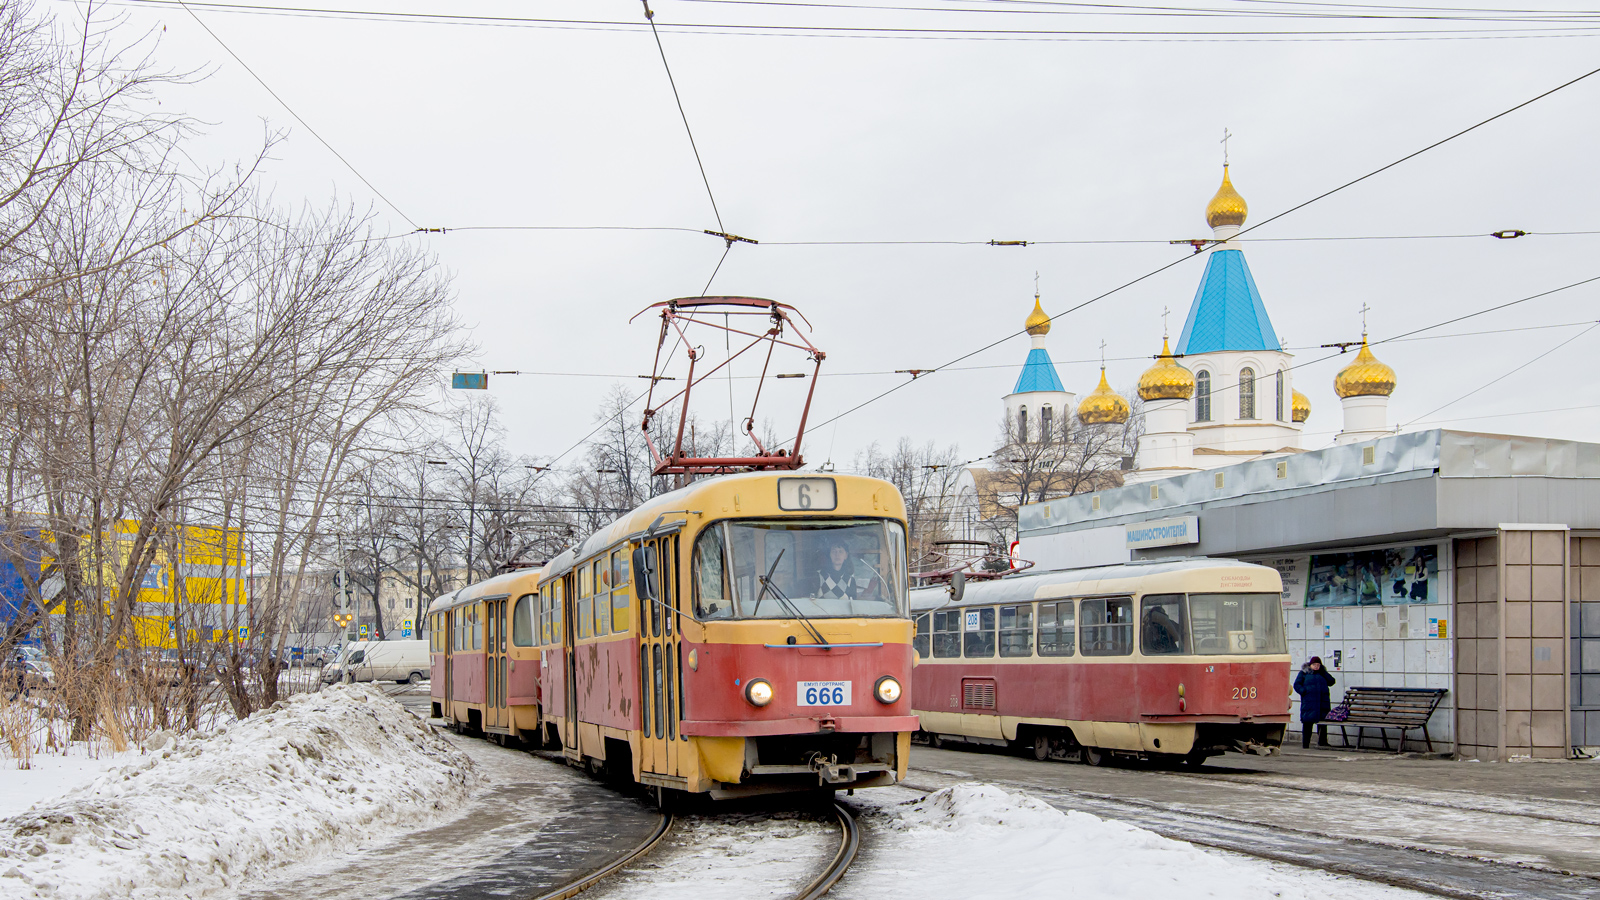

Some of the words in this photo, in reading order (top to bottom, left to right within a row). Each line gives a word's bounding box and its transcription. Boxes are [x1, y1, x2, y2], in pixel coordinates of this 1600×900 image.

[798, 483, 811, 509] 6
[1126, 521, 1187, 542] МАШИНОСТРОИТЕЛЕЙ
[968, 614, 977, 625] 208
[1238, 634, 1248, 650] 8
[806, 687, 843, 705] 666
[1232, 686, 1257, 700] 208
